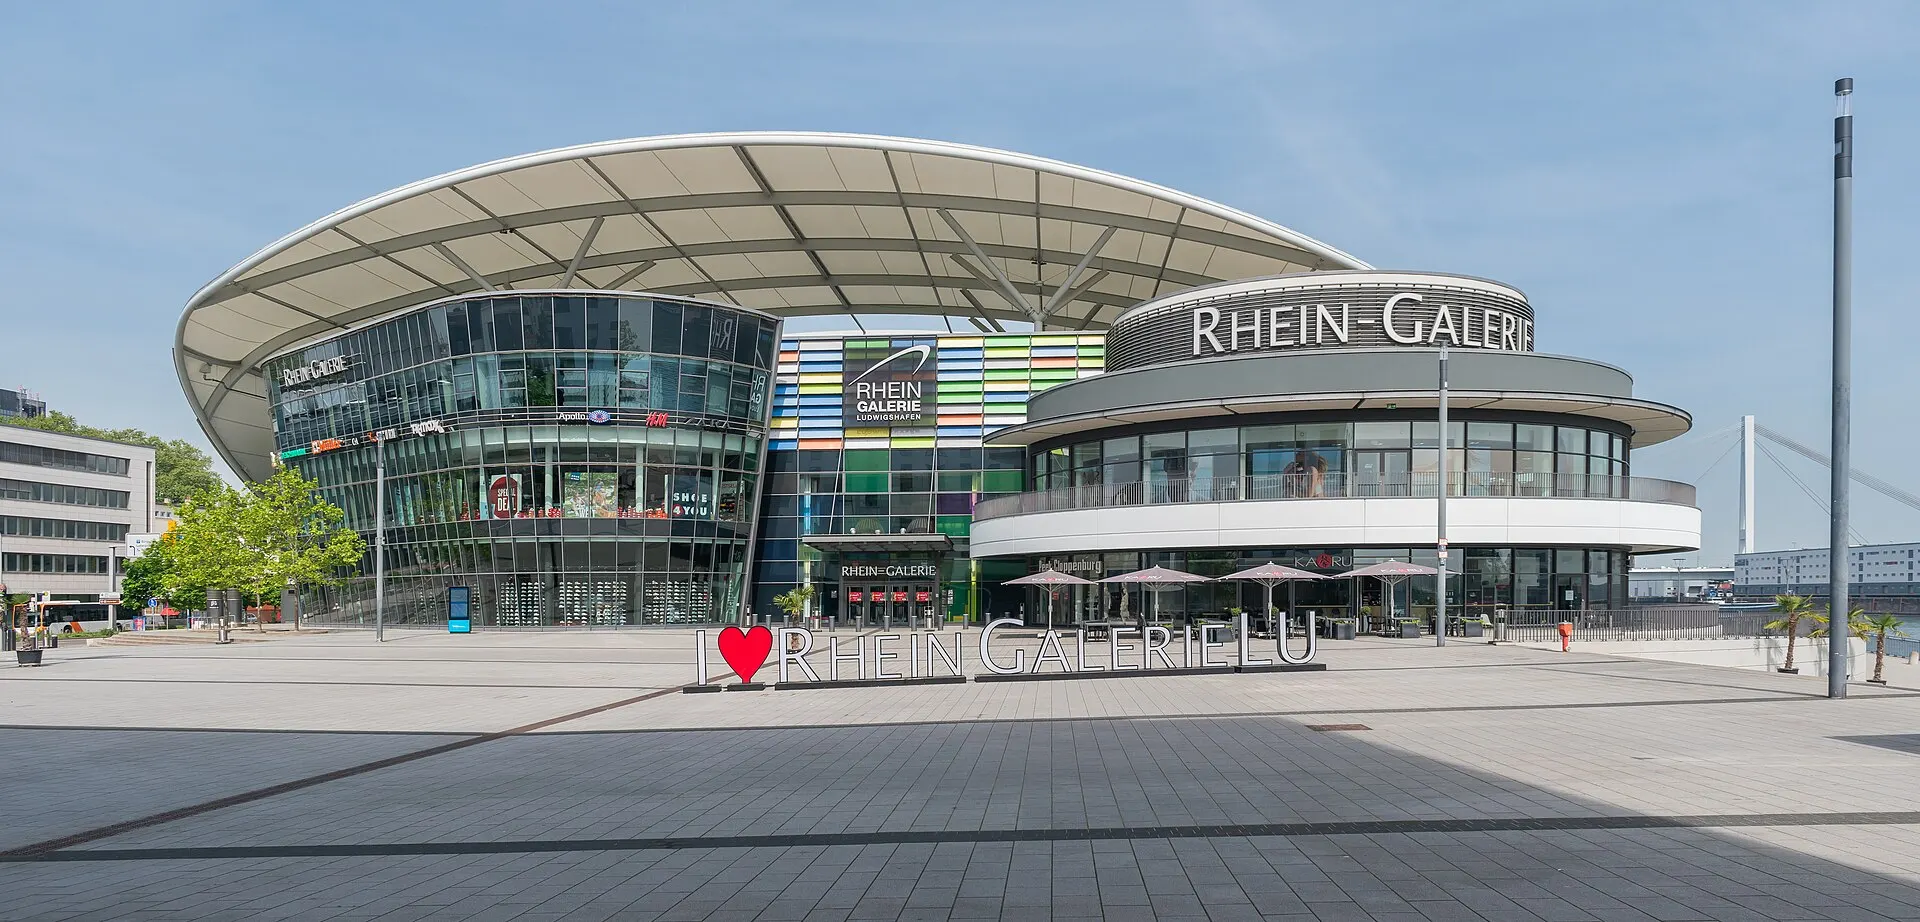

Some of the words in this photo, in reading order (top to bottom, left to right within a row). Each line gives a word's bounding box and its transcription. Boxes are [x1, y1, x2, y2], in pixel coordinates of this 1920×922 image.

[857, 382, 921, 399] RHEIN
[857, 400, 921, 413] GALERIE
[558, 411, 586, 422] Apollo
[497, 488, 516, 497] SPECL
[673, 492, 708, 503] SHOE
[841, 565, 937, 577] RHEIN-GALERIE
[1053, 559, 1101, 574] Cloppenburg
[695, 629, 707, 686] I
[778, 627, 964, 683] RHEIN
[979, 618, 1229, 675] GALERIE
[1238, 610, 1318, 666] LU
